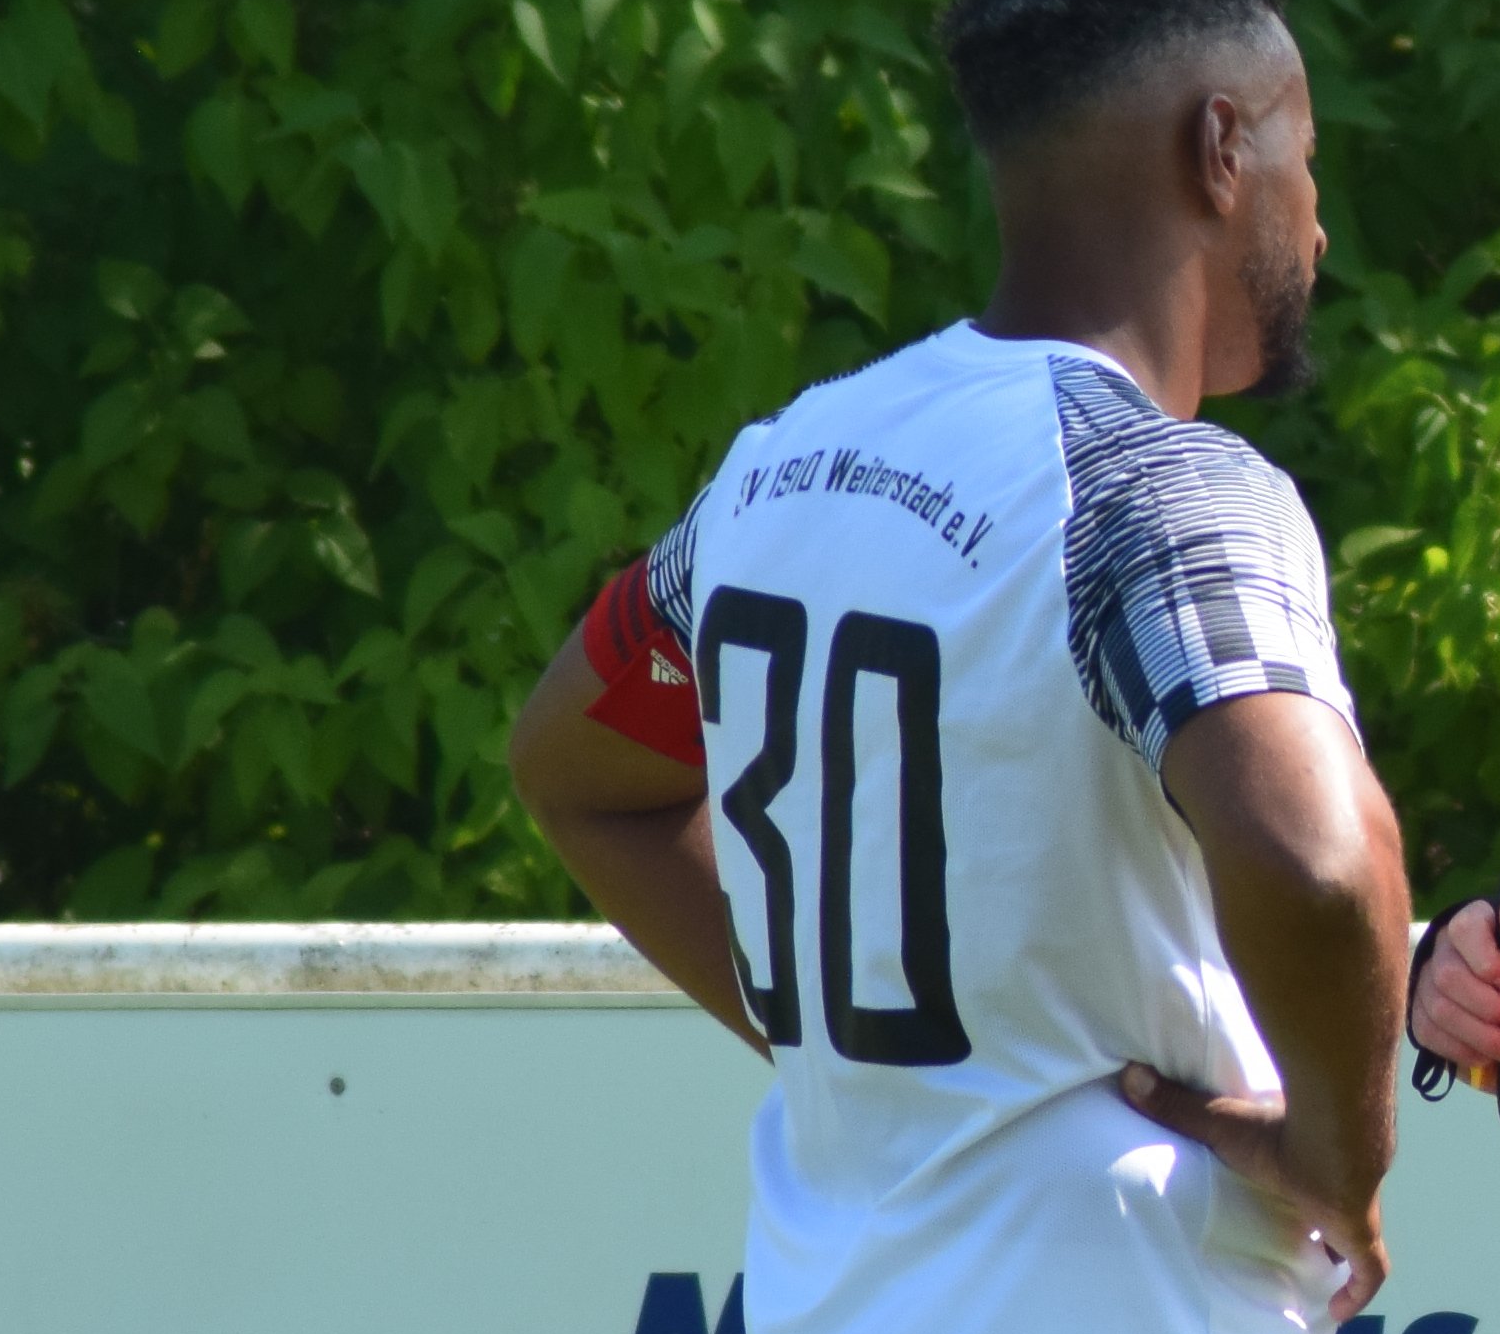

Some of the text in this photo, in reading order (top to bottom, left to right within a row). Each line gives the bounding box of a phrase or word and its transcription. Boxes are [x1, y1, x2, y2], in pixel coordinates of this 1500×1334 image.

[824, 448, 954, 528] Weiterstadt
[941, 511, 994, 569] e.V.
[700, 585, 972, 1066] 30
